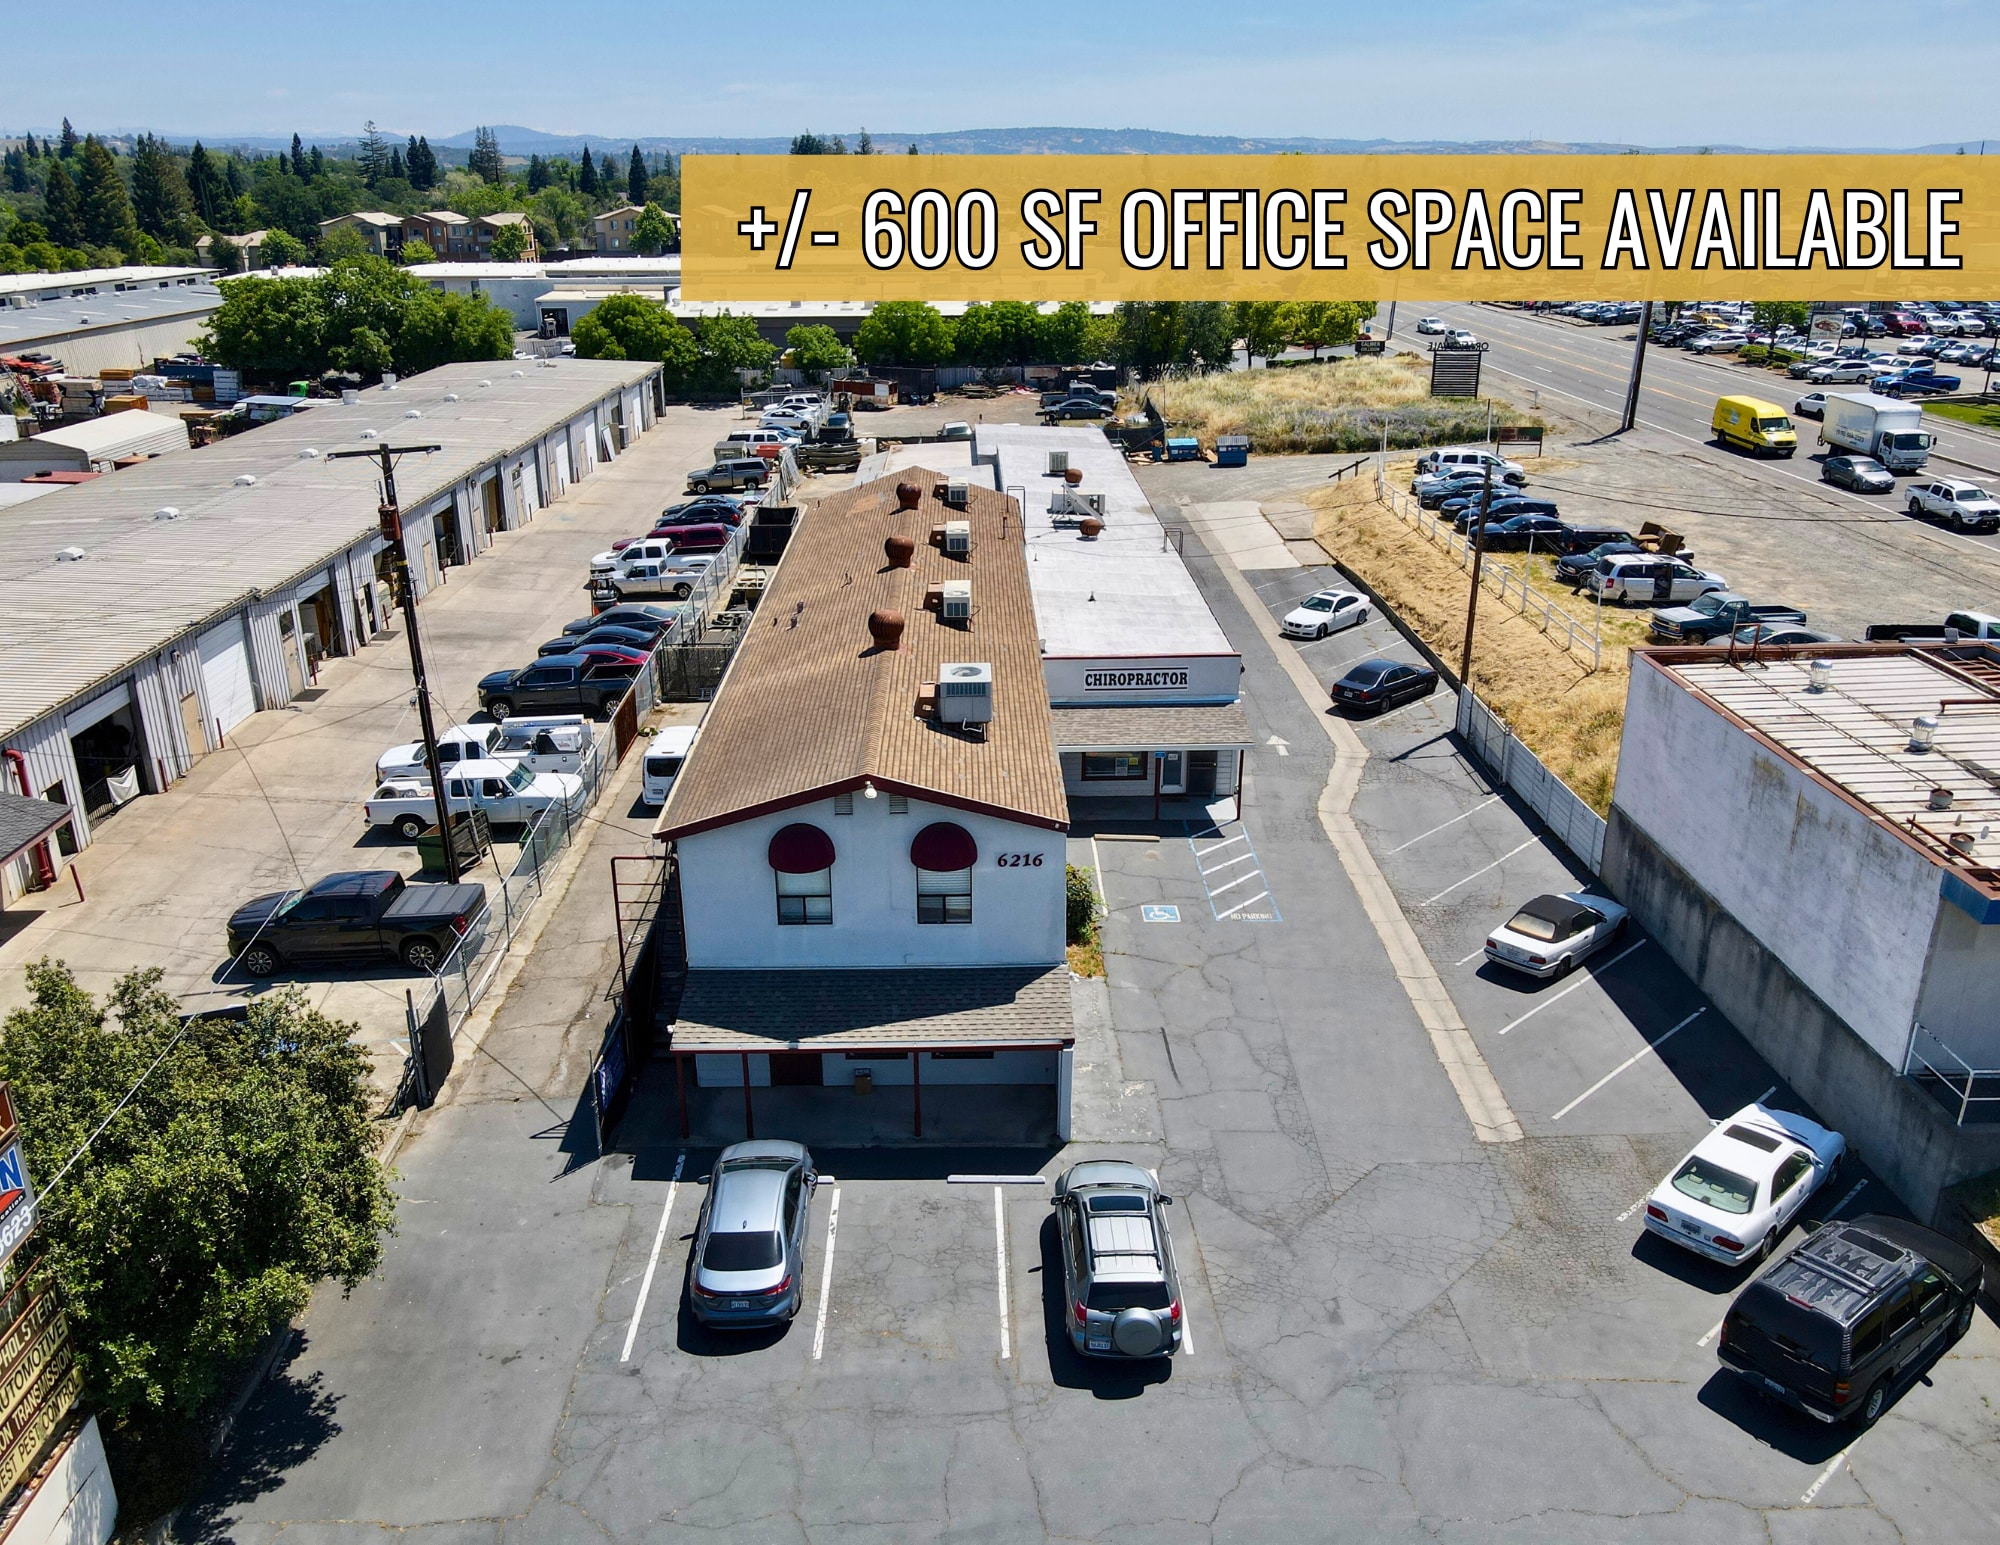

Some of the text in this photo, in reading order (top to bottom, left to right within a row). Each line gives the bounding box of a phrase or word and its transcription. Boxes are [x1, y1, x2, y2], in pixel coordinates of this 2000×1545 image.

[1085, 672, 1188, 686] CHIROPRACTOR
[997, 853, 1044, 868] 6216
[1242, 912, 1273, 920] PARKING
[0, 1284, 58, 1376] HOLSTERY
[11, 1343, 72, 1431] TRANSMISSION
[0, 1372, 80, 1494] EST PEST CONTROL
